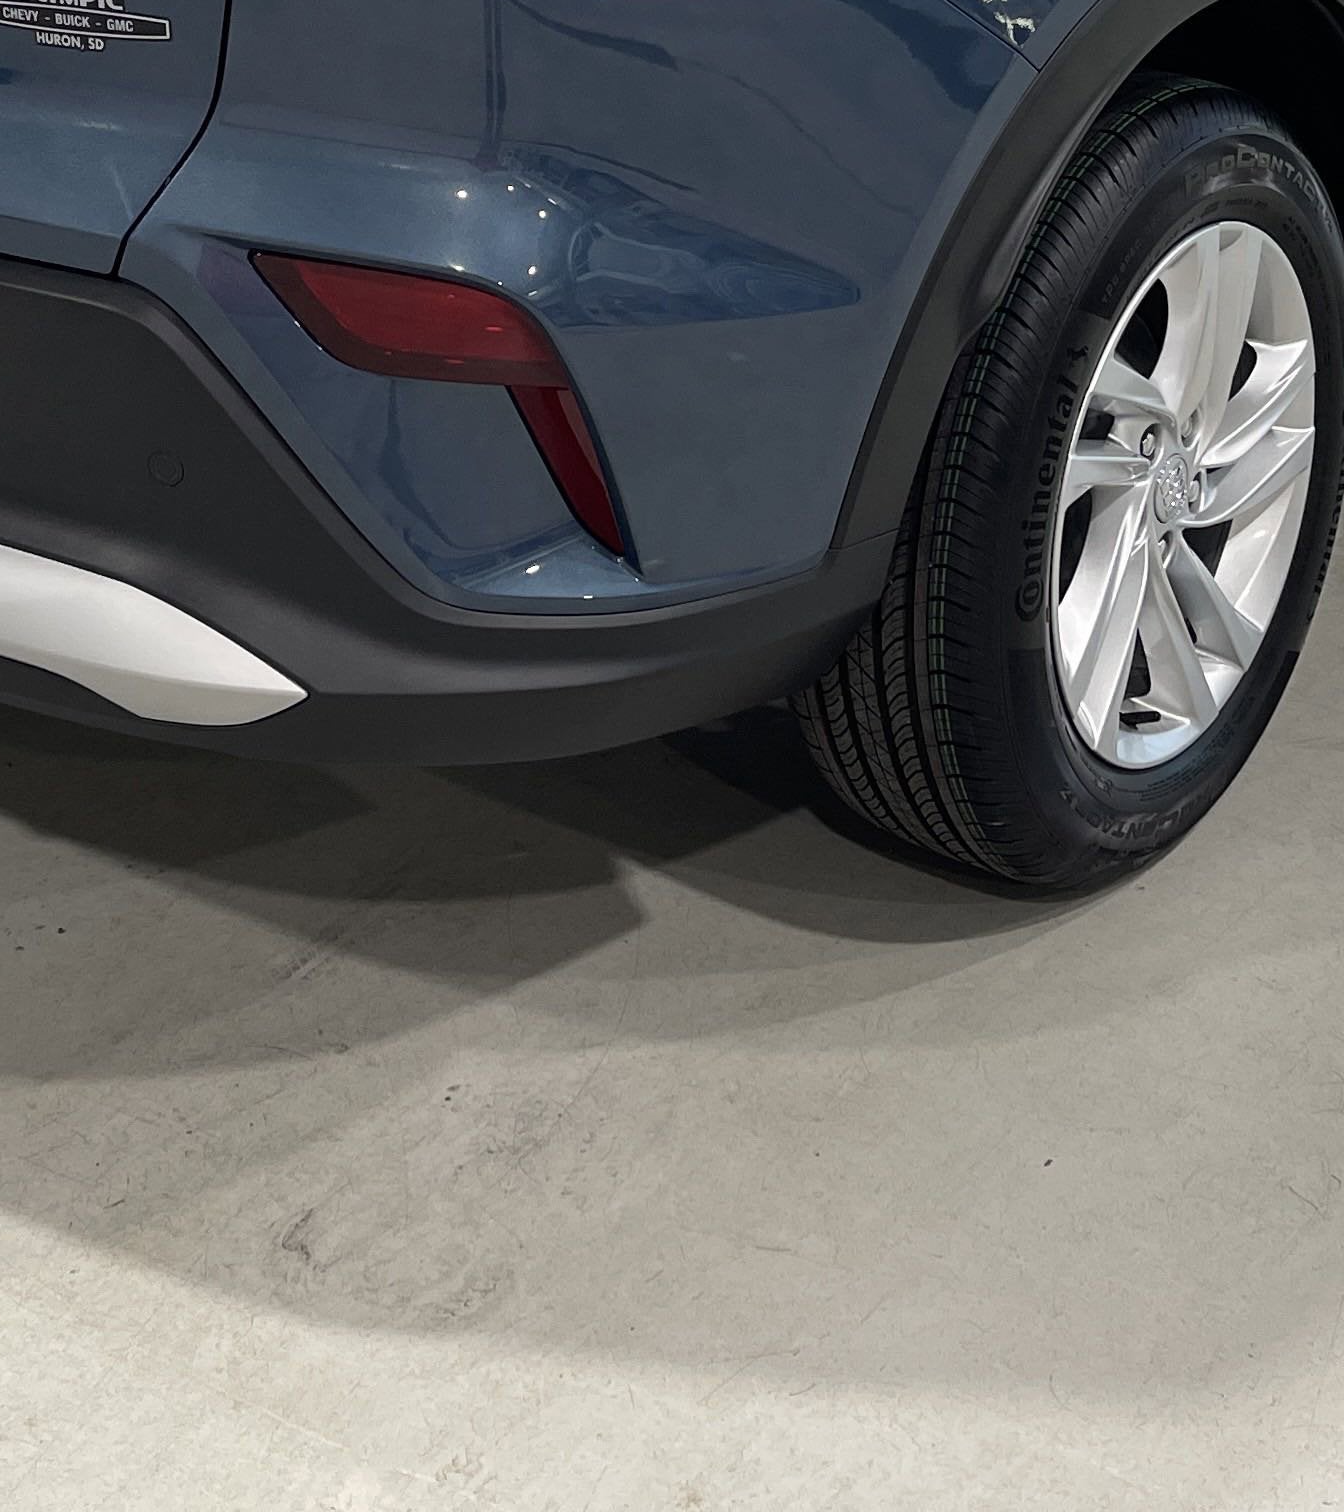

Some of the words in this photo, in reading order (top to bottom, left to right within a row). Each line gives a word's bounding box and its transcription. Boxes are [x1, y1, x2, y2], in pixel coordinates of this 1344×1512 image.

[2, 6, 39, 23] CHEVY
[55, 12, 91, 29] BUICK
[106, 19, 135, 33] GMC
[35, 31, 86, 50] HURON,
[88, 37, 105, 51] SD
[1014, 373, 1080, 623] Continental
